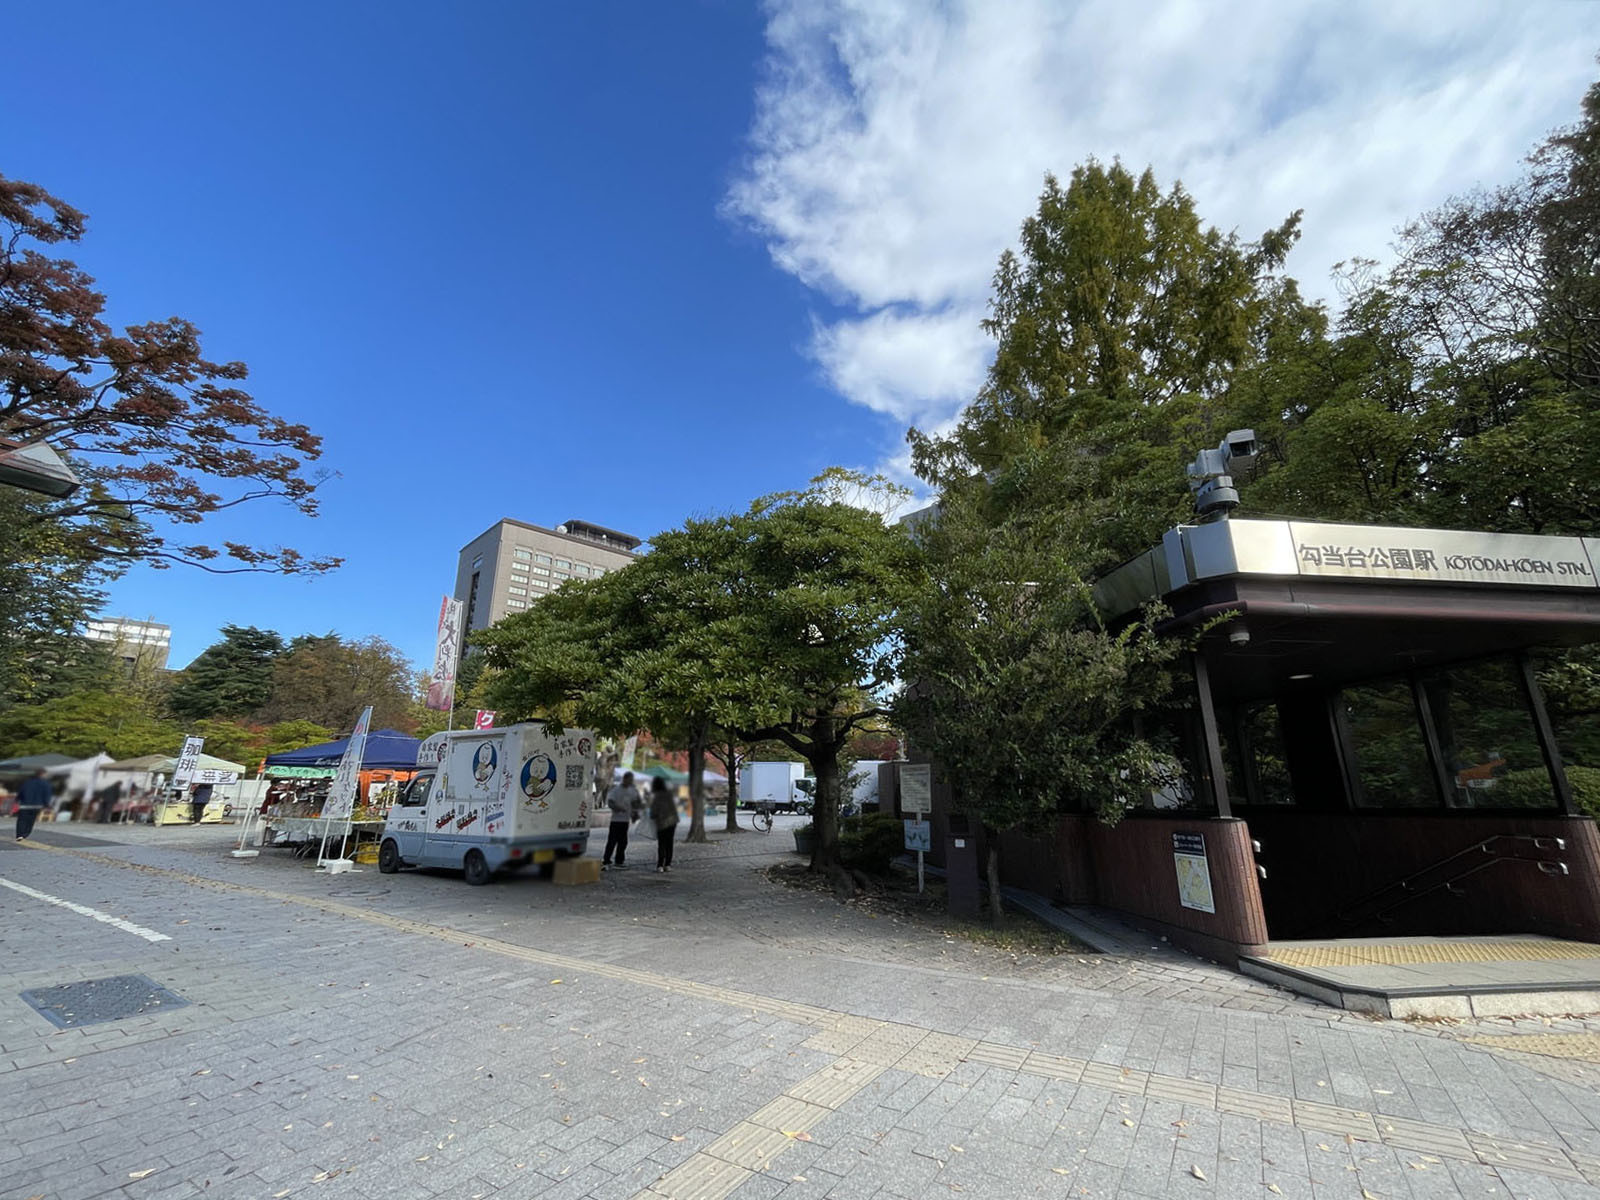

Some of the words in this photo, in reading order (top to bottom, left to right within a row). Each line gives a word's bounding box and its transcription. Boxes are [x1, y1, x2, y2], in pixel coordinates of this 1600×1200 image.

[1299, 543, 1438, 571] 勾当台公園駅
[1557, 561, 1591, 576] STN.
[178, 744, 201, 772] 珈琲
